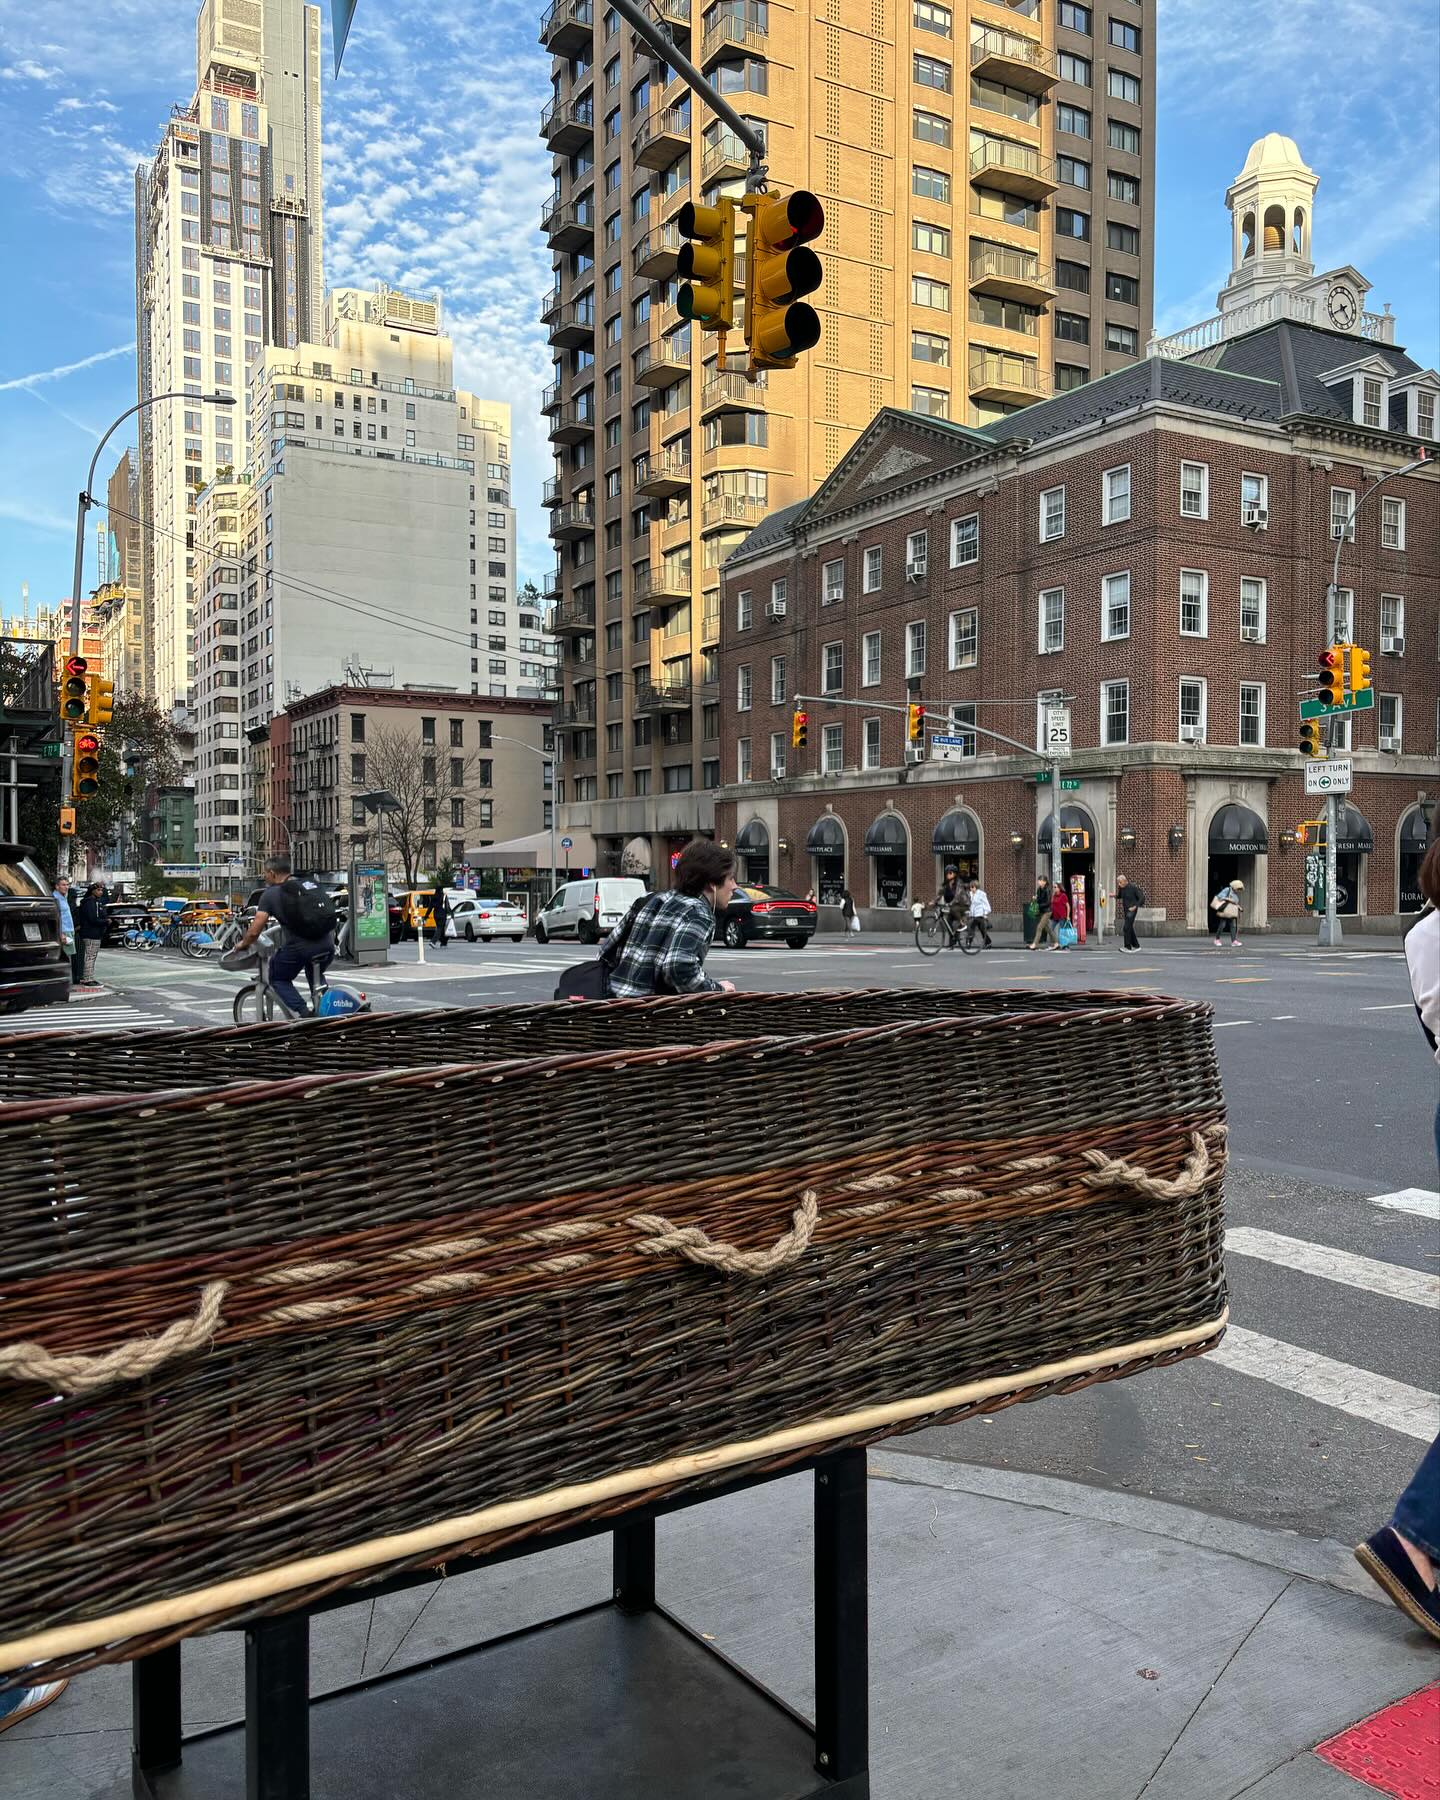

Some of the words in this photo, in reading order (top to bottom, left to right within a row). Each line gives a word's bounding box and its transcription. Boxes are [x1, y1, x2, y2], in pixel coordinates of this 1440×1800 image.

[1050, 728, 1068, 742] 25
[1308, 765, 1326, 774] LEFT
[1328, 763, 1348, 772] TURN
[1332, 778, 1349, 786] ONLY
[1229, 843, 1259, 851] MORTON
[1400, 891, 1424, 901] FLORAL
